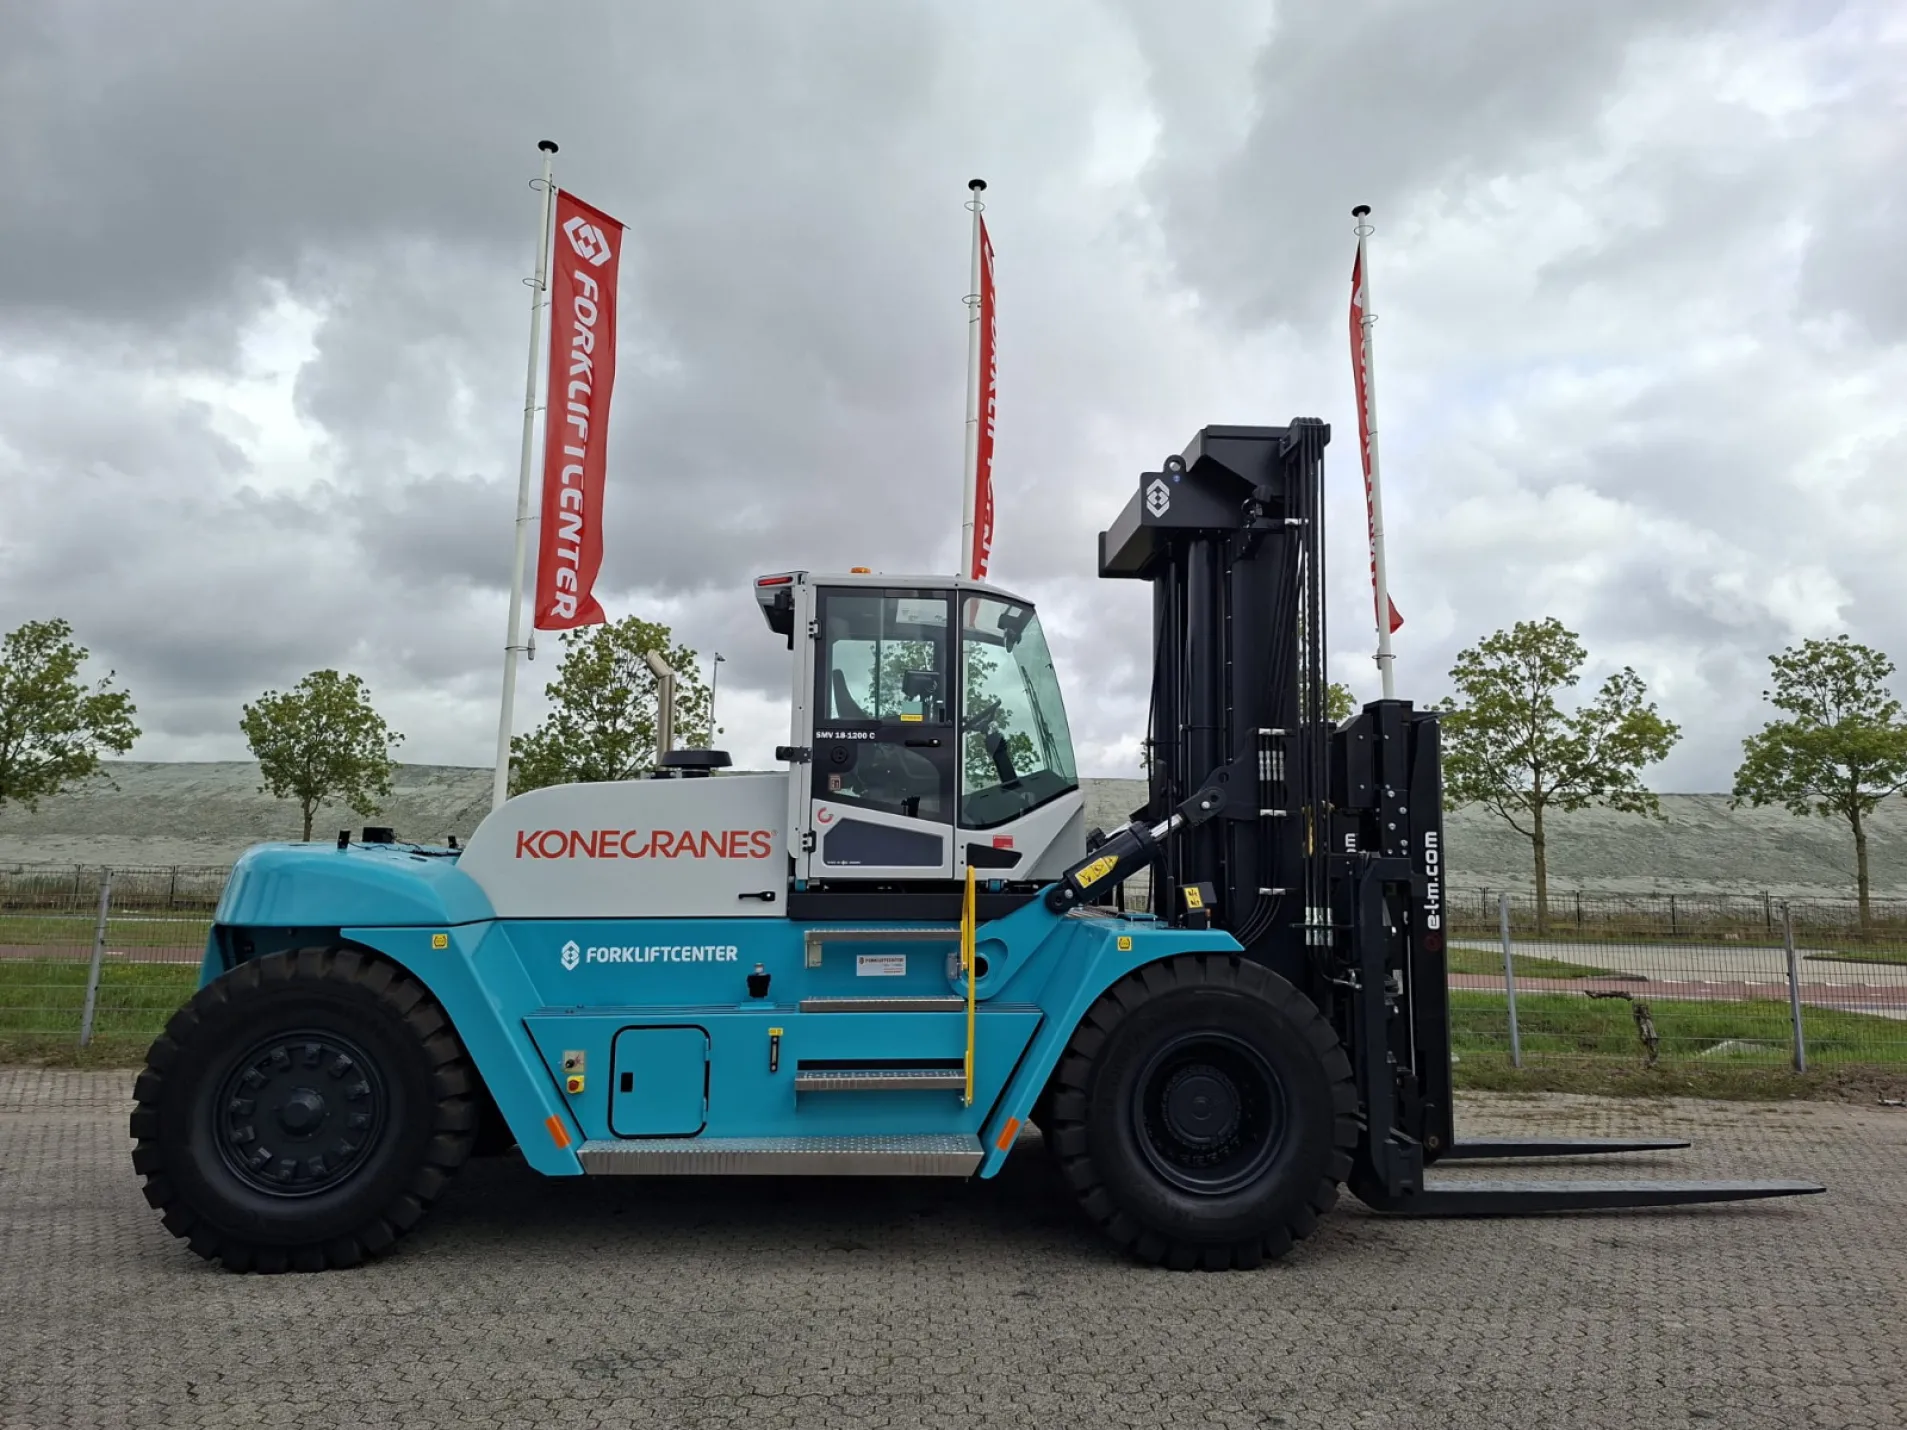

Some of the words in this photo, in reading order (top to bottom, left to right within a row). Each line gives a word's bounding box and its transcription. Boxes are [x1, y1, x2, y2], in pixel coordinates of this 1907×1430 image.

[550, 269, 599, 620] FORKLIFTCENTER
[815, 731, 834, 739] SMV
[869, 732, 876, 740] C
[515, 829, 772, 859] KONECRANES
[586, 945, 738, 964] FORKLIFTCENTER
